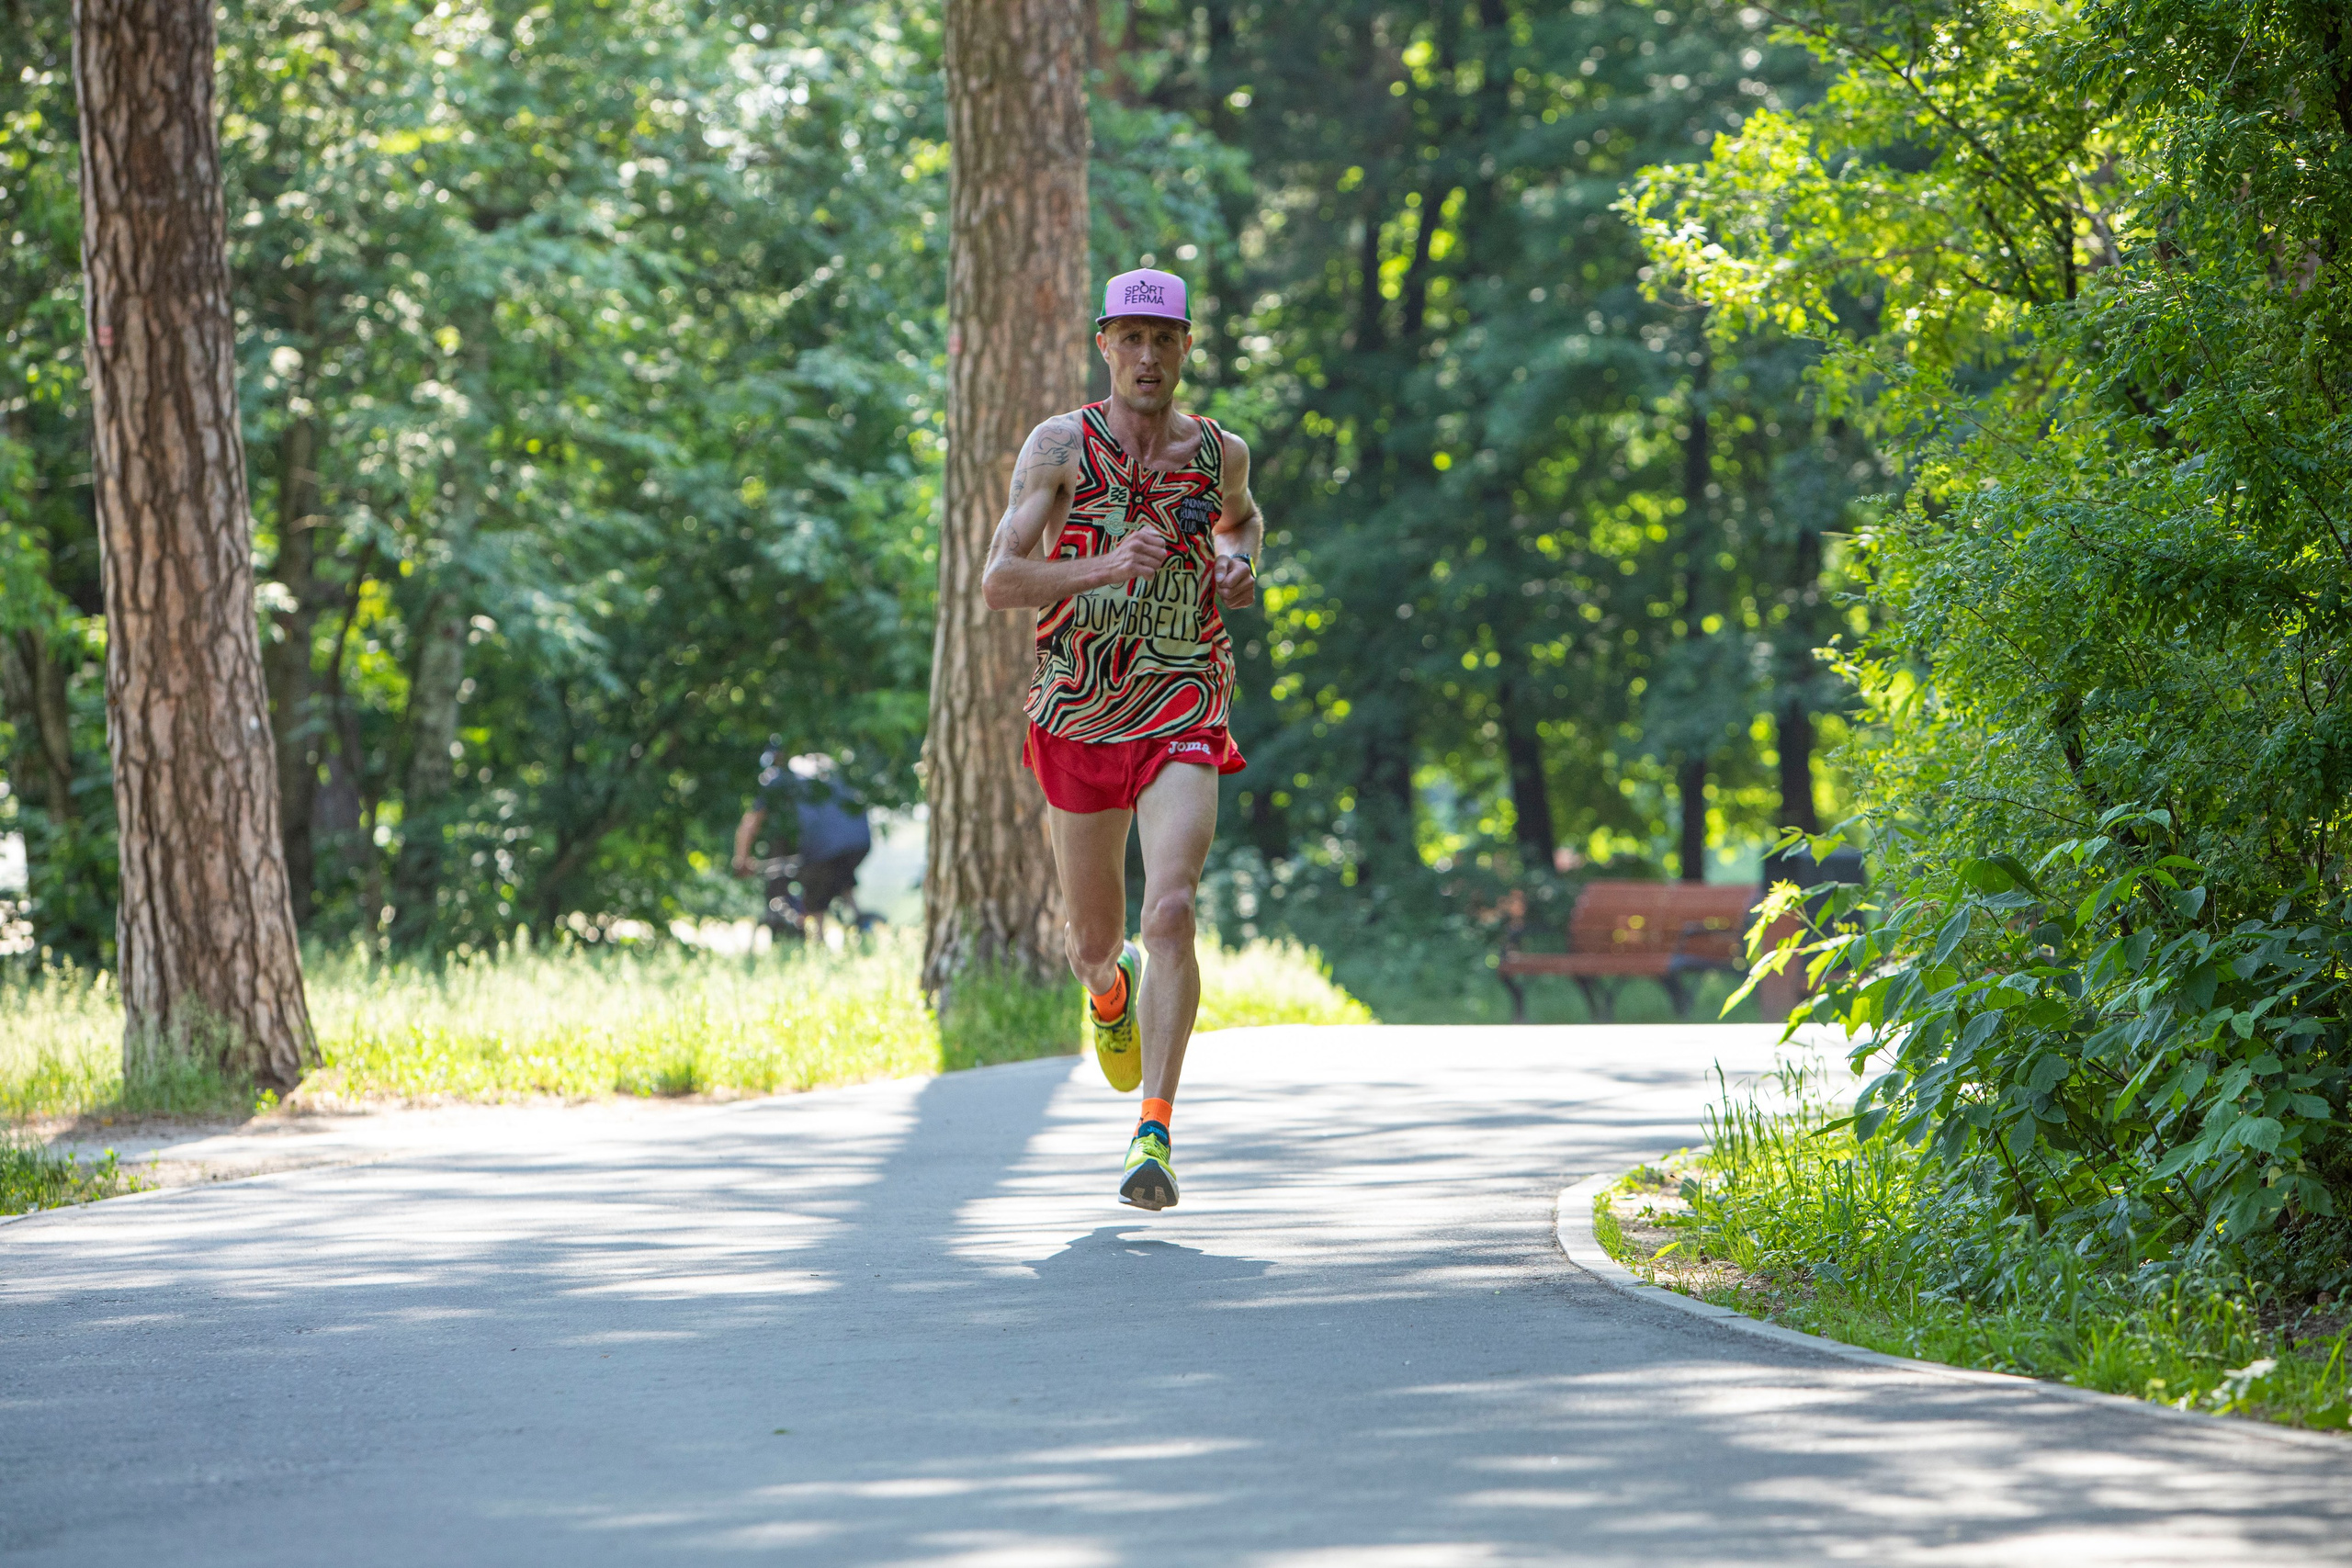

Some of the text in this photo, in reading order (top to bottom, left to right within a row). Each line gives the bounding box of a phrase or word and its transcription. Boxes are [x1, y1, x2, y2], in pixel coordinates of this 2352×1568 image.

[1125, 285, 1165, 296] SPORT
[1125, 294, 1165, 306] FERMA
[1181, 506, 1209, 524] RUNNING
[1179, 518, 1197, 533] CLUB
[1074, 594, 1200, 643] DUMBBELLS
[1169, 741, 1211, 755] Joma
